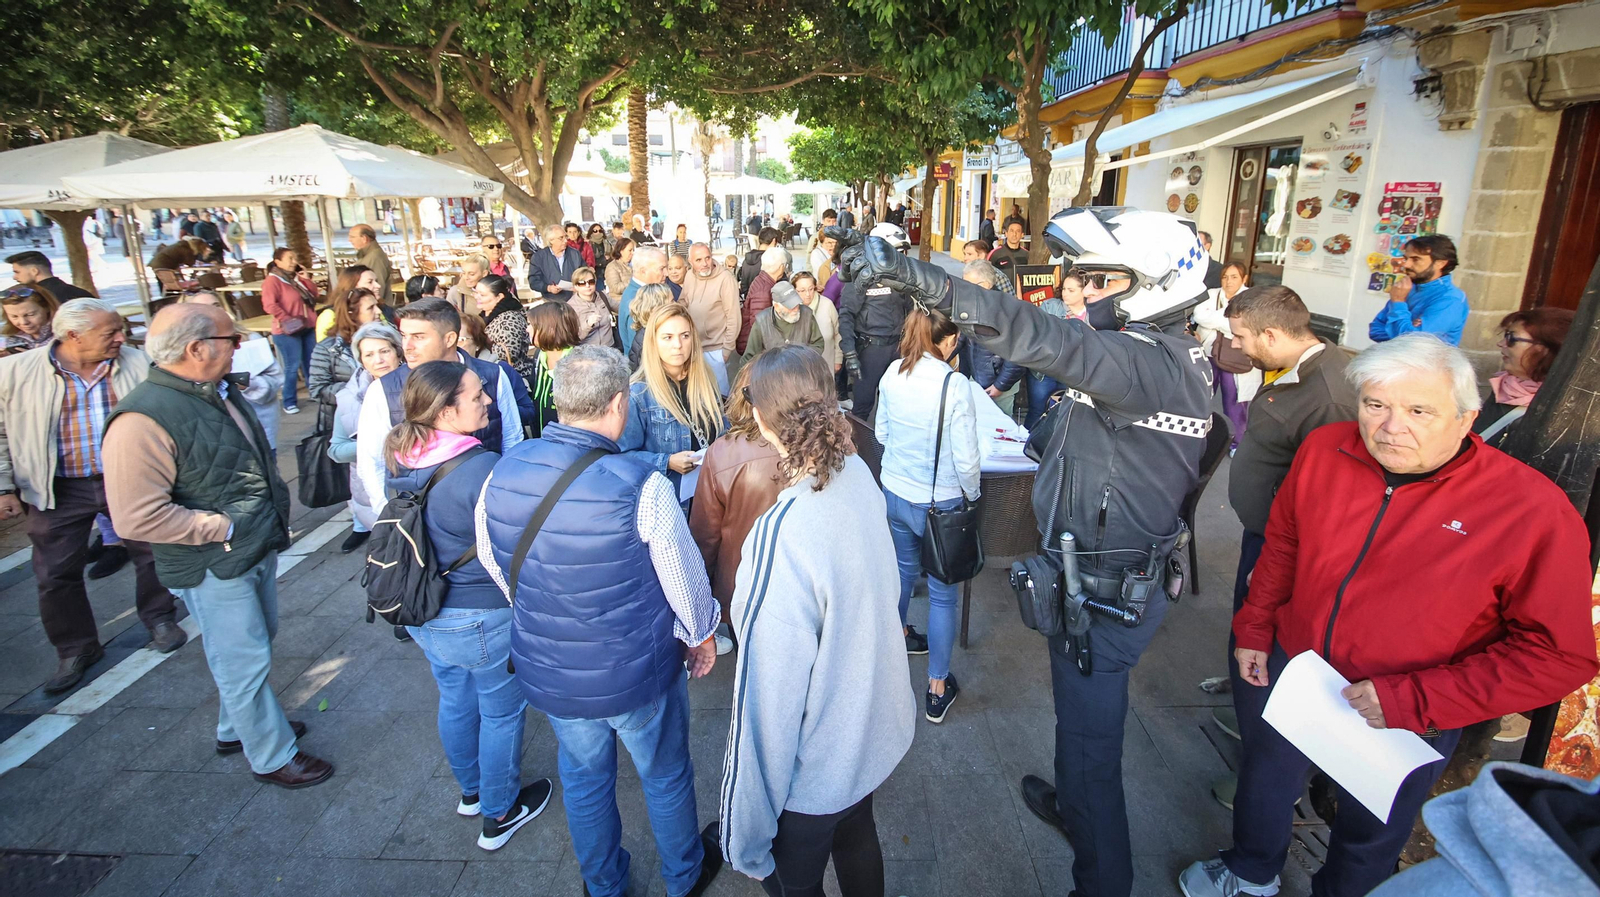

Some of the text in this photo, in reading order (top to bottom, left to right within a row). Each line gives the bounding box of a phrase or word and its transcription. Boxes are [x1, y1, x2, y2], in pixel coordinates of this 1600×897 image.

[264, 174, 320, 186] AMSTEL
[1022, 274, 1055, 287] KITCHEN
[1029, 290, 1046, 303] OPEN
